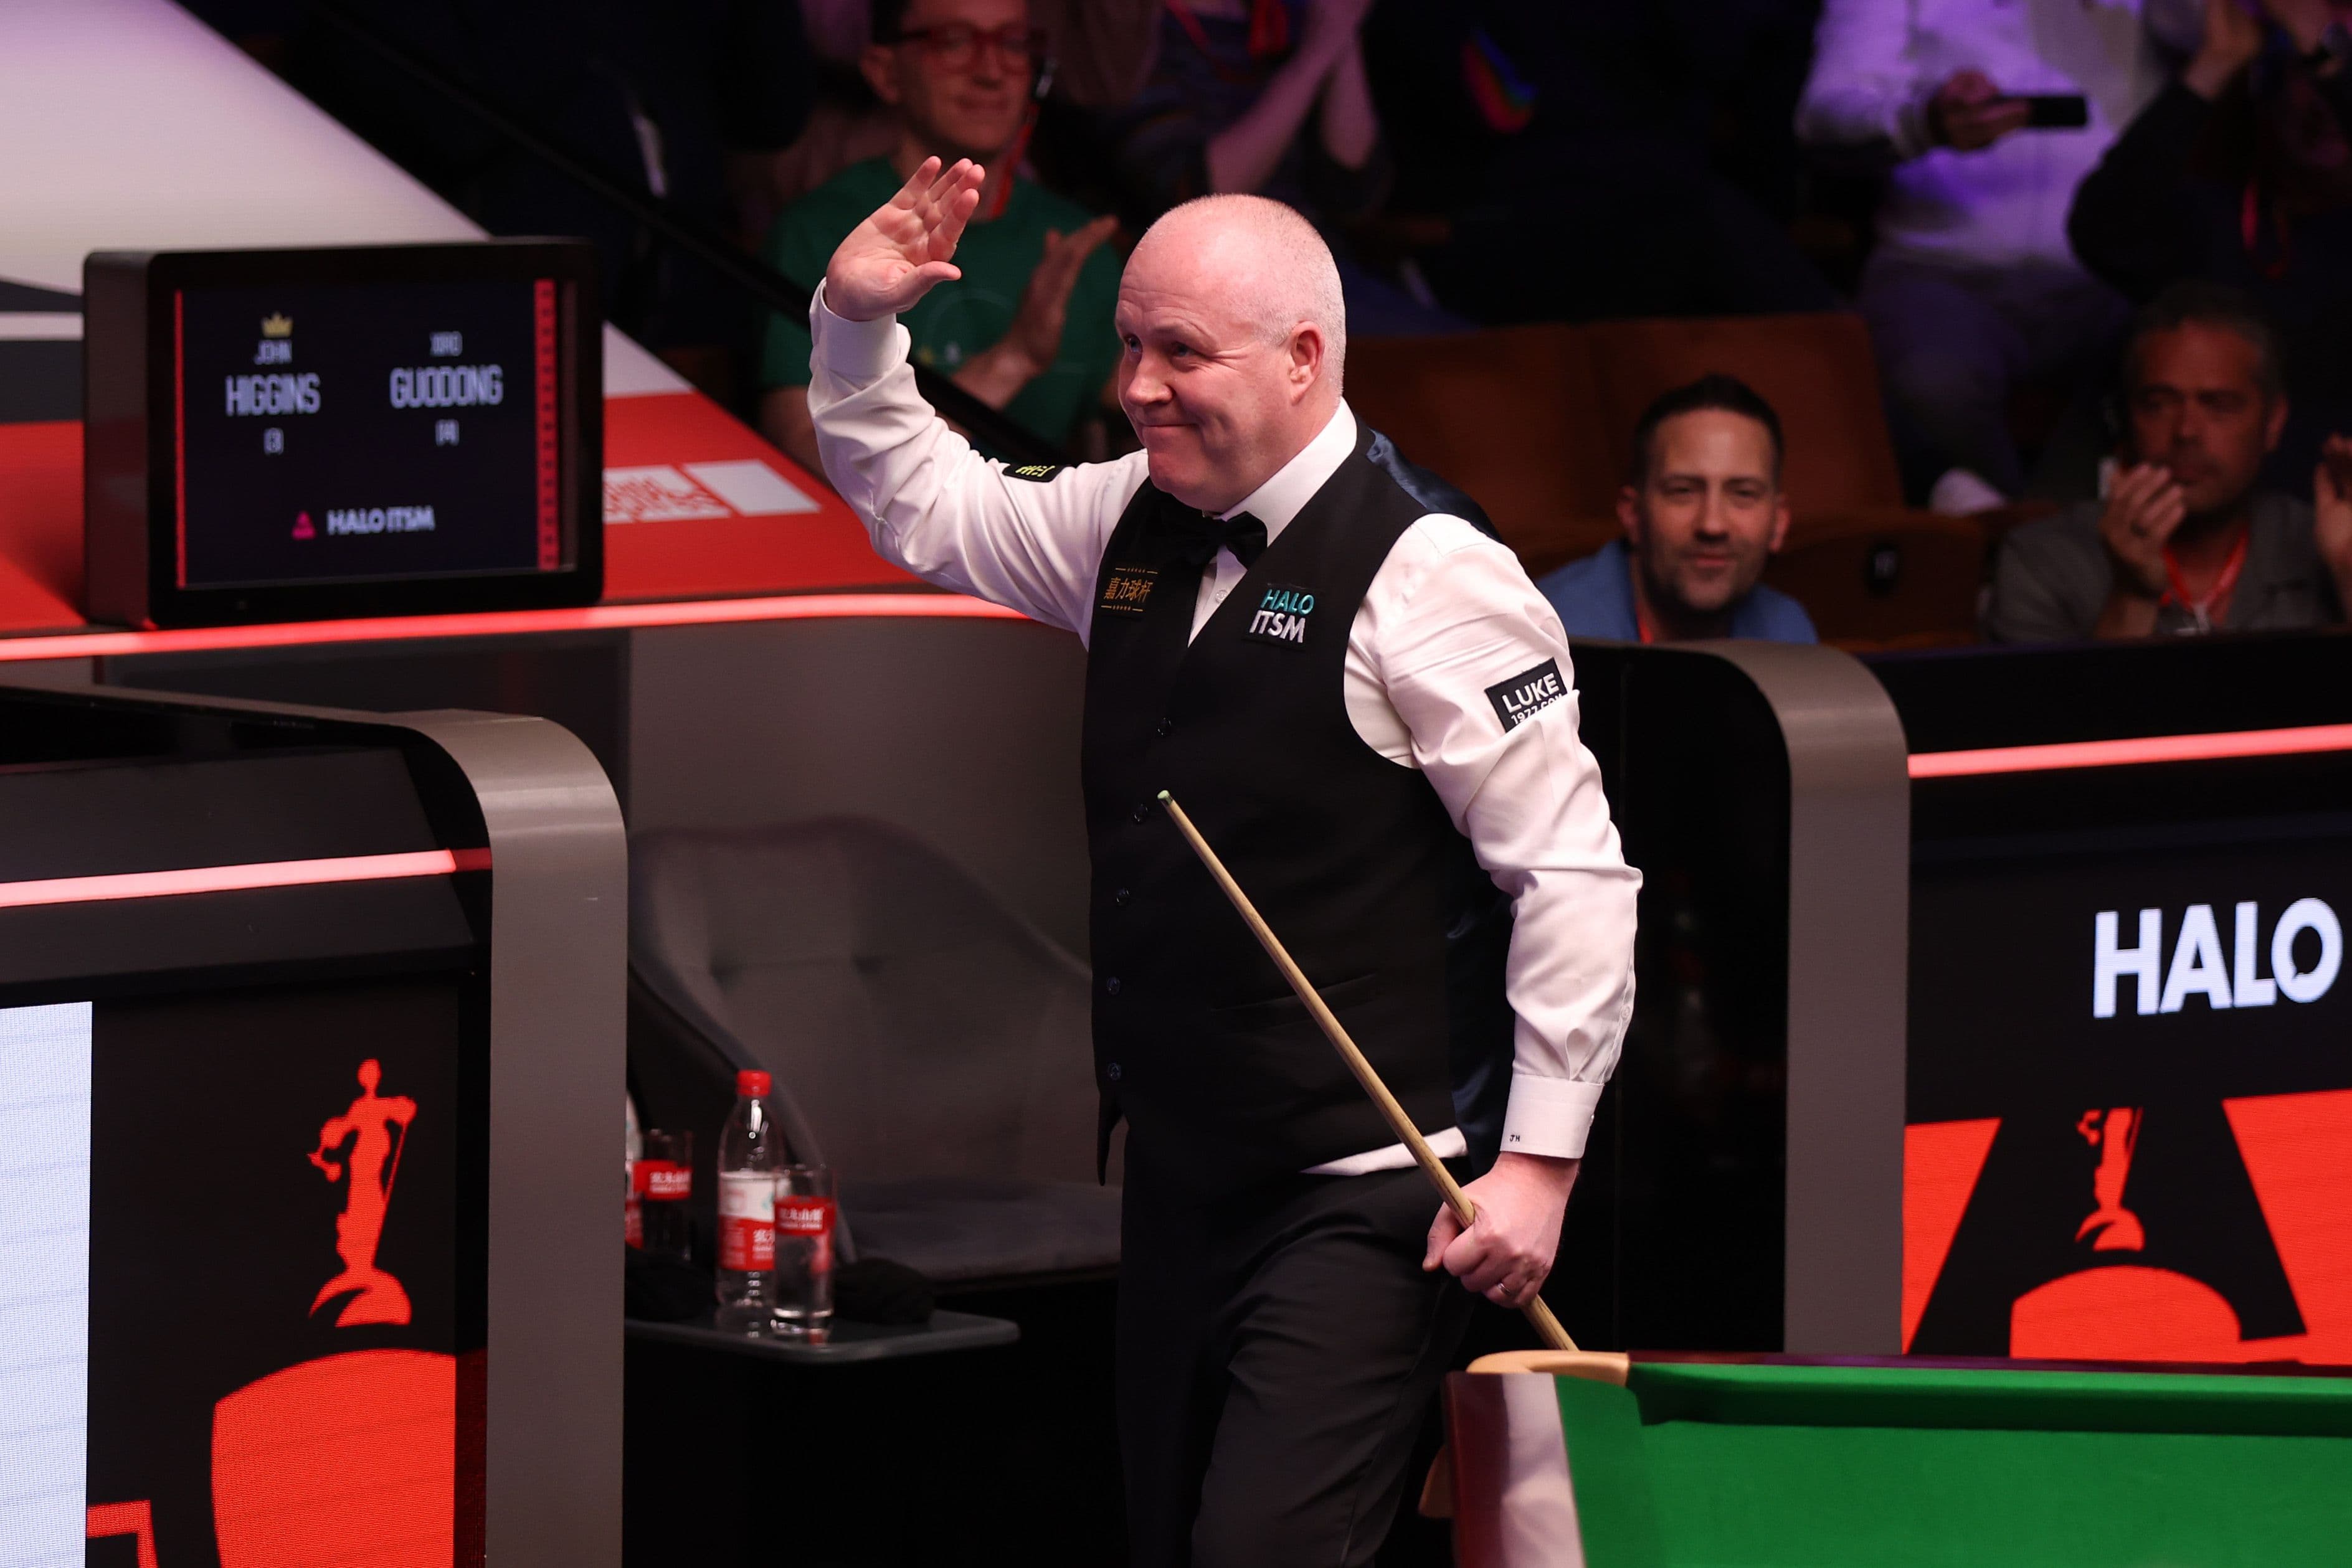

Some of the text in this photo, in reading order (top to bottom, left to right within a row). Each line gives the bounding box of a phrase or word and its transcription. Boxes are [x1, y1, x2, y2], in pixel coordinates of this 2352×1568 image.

[225, 372, 321, 416] HIGGINS
[391, 364, 503, 409] GUODONG
[326, 508, 385, 535] HALO
[1260, 588, 1315, 615] HALO
[1249, 610, 1306, 643] ITSM
[1502, 673, 1560, 714] LUKE
[2093, 897, 2344, 1019] HALO
